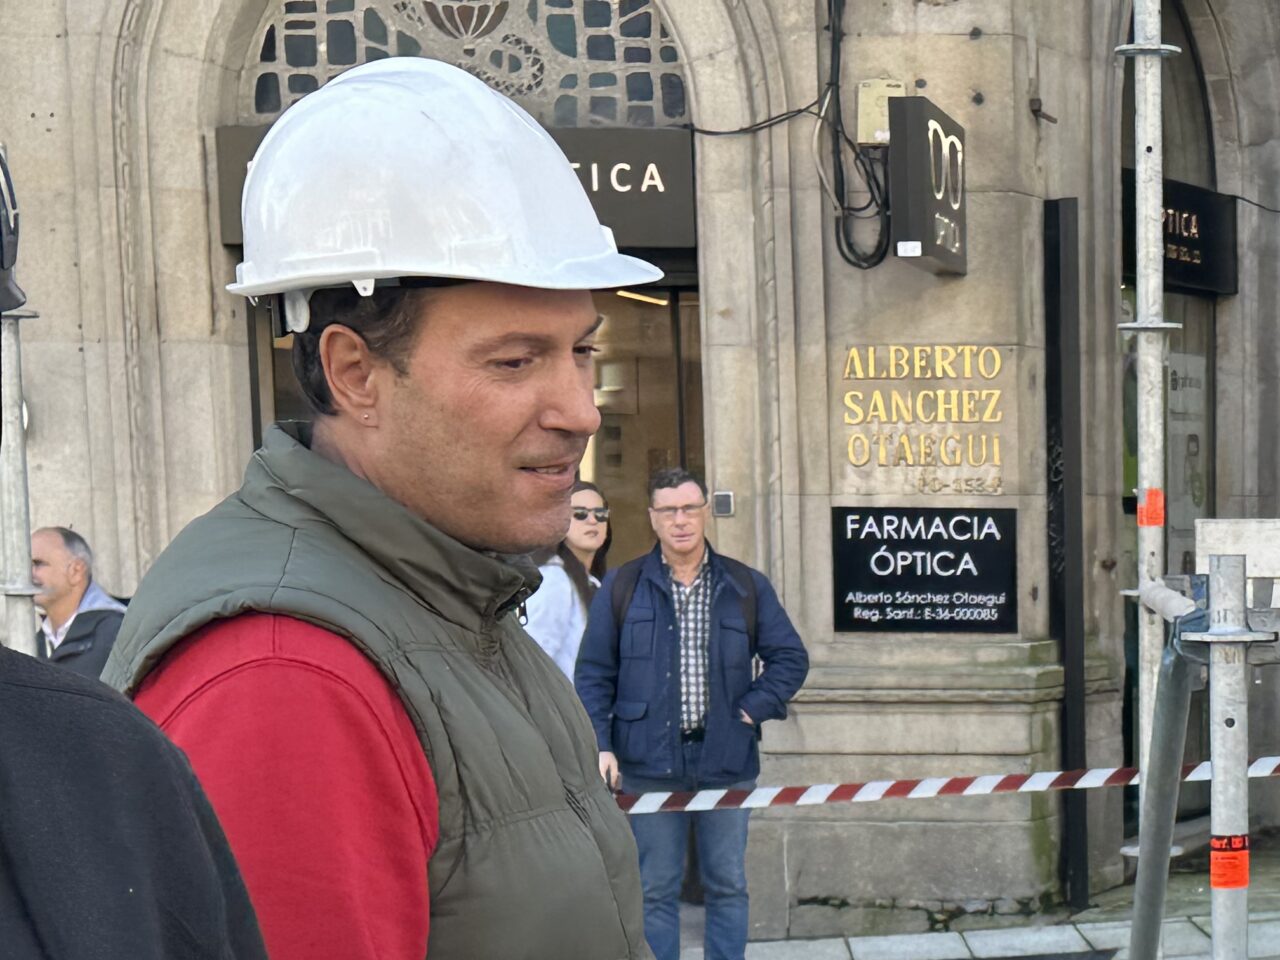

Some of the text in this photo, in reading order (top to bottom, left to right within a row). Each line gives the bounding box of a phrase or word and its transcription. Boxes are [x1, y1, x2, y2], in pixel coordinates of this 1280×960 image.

[843, 345, 1002, 380] ALBERTO
[843, 389, 1003, 425] SANCHEZ
[847, 433, 1001, 468] OTAEGUI
[846, 514, 1002, 541] FARMACIA
[869, 545, 979, 577] ÓPTICA
[845, 591, 893, 605] Alberto
[952, 592, 1007, 607] Otaegui
[853, 606, 883, 622] Reg.
